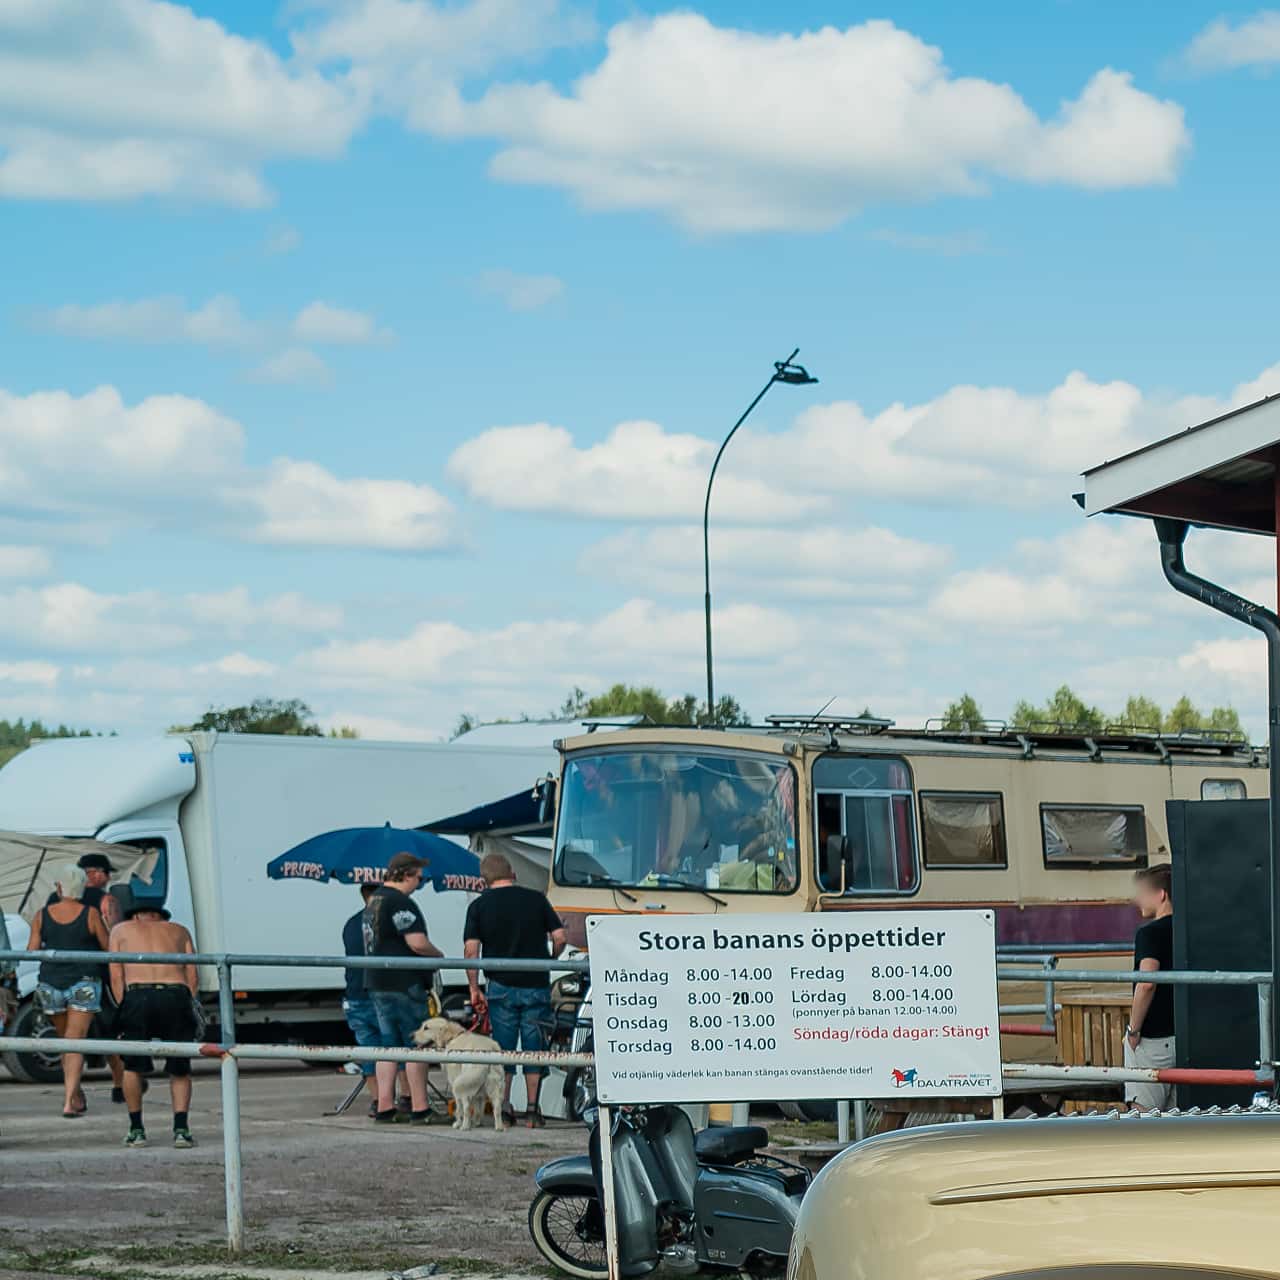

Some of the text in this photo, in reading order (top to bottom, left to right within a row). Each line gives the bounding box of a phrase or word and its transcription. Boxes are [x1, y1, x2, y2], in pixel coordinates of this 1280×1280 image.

[353, 867, 388, 882] PRI
[639, 927, 945, 952] Stora banans öppettider
[604, 969, 669, 985] Måndag
[686, 969, 719, 981] 8.00
[790, 965, 952, 982] Fredag 8.00-14.00
[605, 993, 657, 1008] Tisdag
[688, 993, 721, 1004] 8.00
[792, 988, 953, 1005] Lördag 8.00-14.00
[792, 1005, 957, 1018] (ponnyer på banan 12.00-14.00)
[607, 1016, 668, 1032] Onsdag
[689, 1016, 722, 1028] 8.00
[793, 1025, 990, 1042] Söndag/röda dagar: Stängt
[608, 1040, 672, 1055] Torsdag
[691, 1039, 723, 1051] 8.00
[612, 1071, 626, 1079] Vid
[630, 1071, 664, 1080] otjänlig
[667, 1070, 703, 1078] väderlek
[725, 1069, 752, 1077] banan
[755, 1069, 789, 1077] stängas
[791, 1067, 847, 1076] ovanstående
[918, 1079, 992, 1087] DALATRAVET
